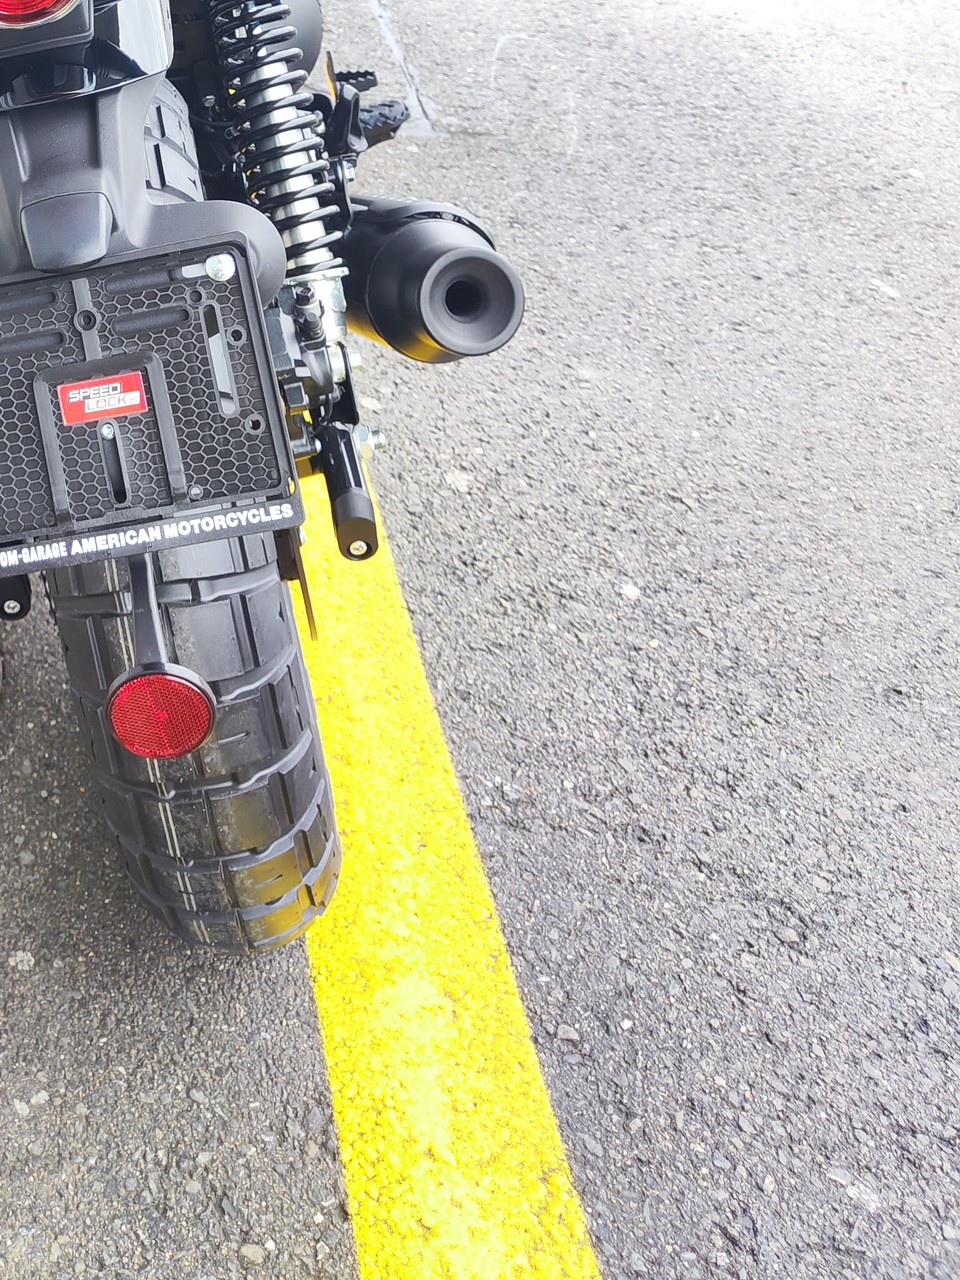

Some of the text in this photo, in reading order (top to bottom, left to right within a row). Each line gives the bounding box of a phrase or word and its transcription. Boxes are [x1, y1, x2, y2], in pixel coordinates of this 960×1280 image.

[68, 382, 123, 403] SPEED
[86, 394, 127, 411] LOCK
[70, 525, 162, 556] AMERICAN
[162, 503, 294, 539] MOTORCYCLES
